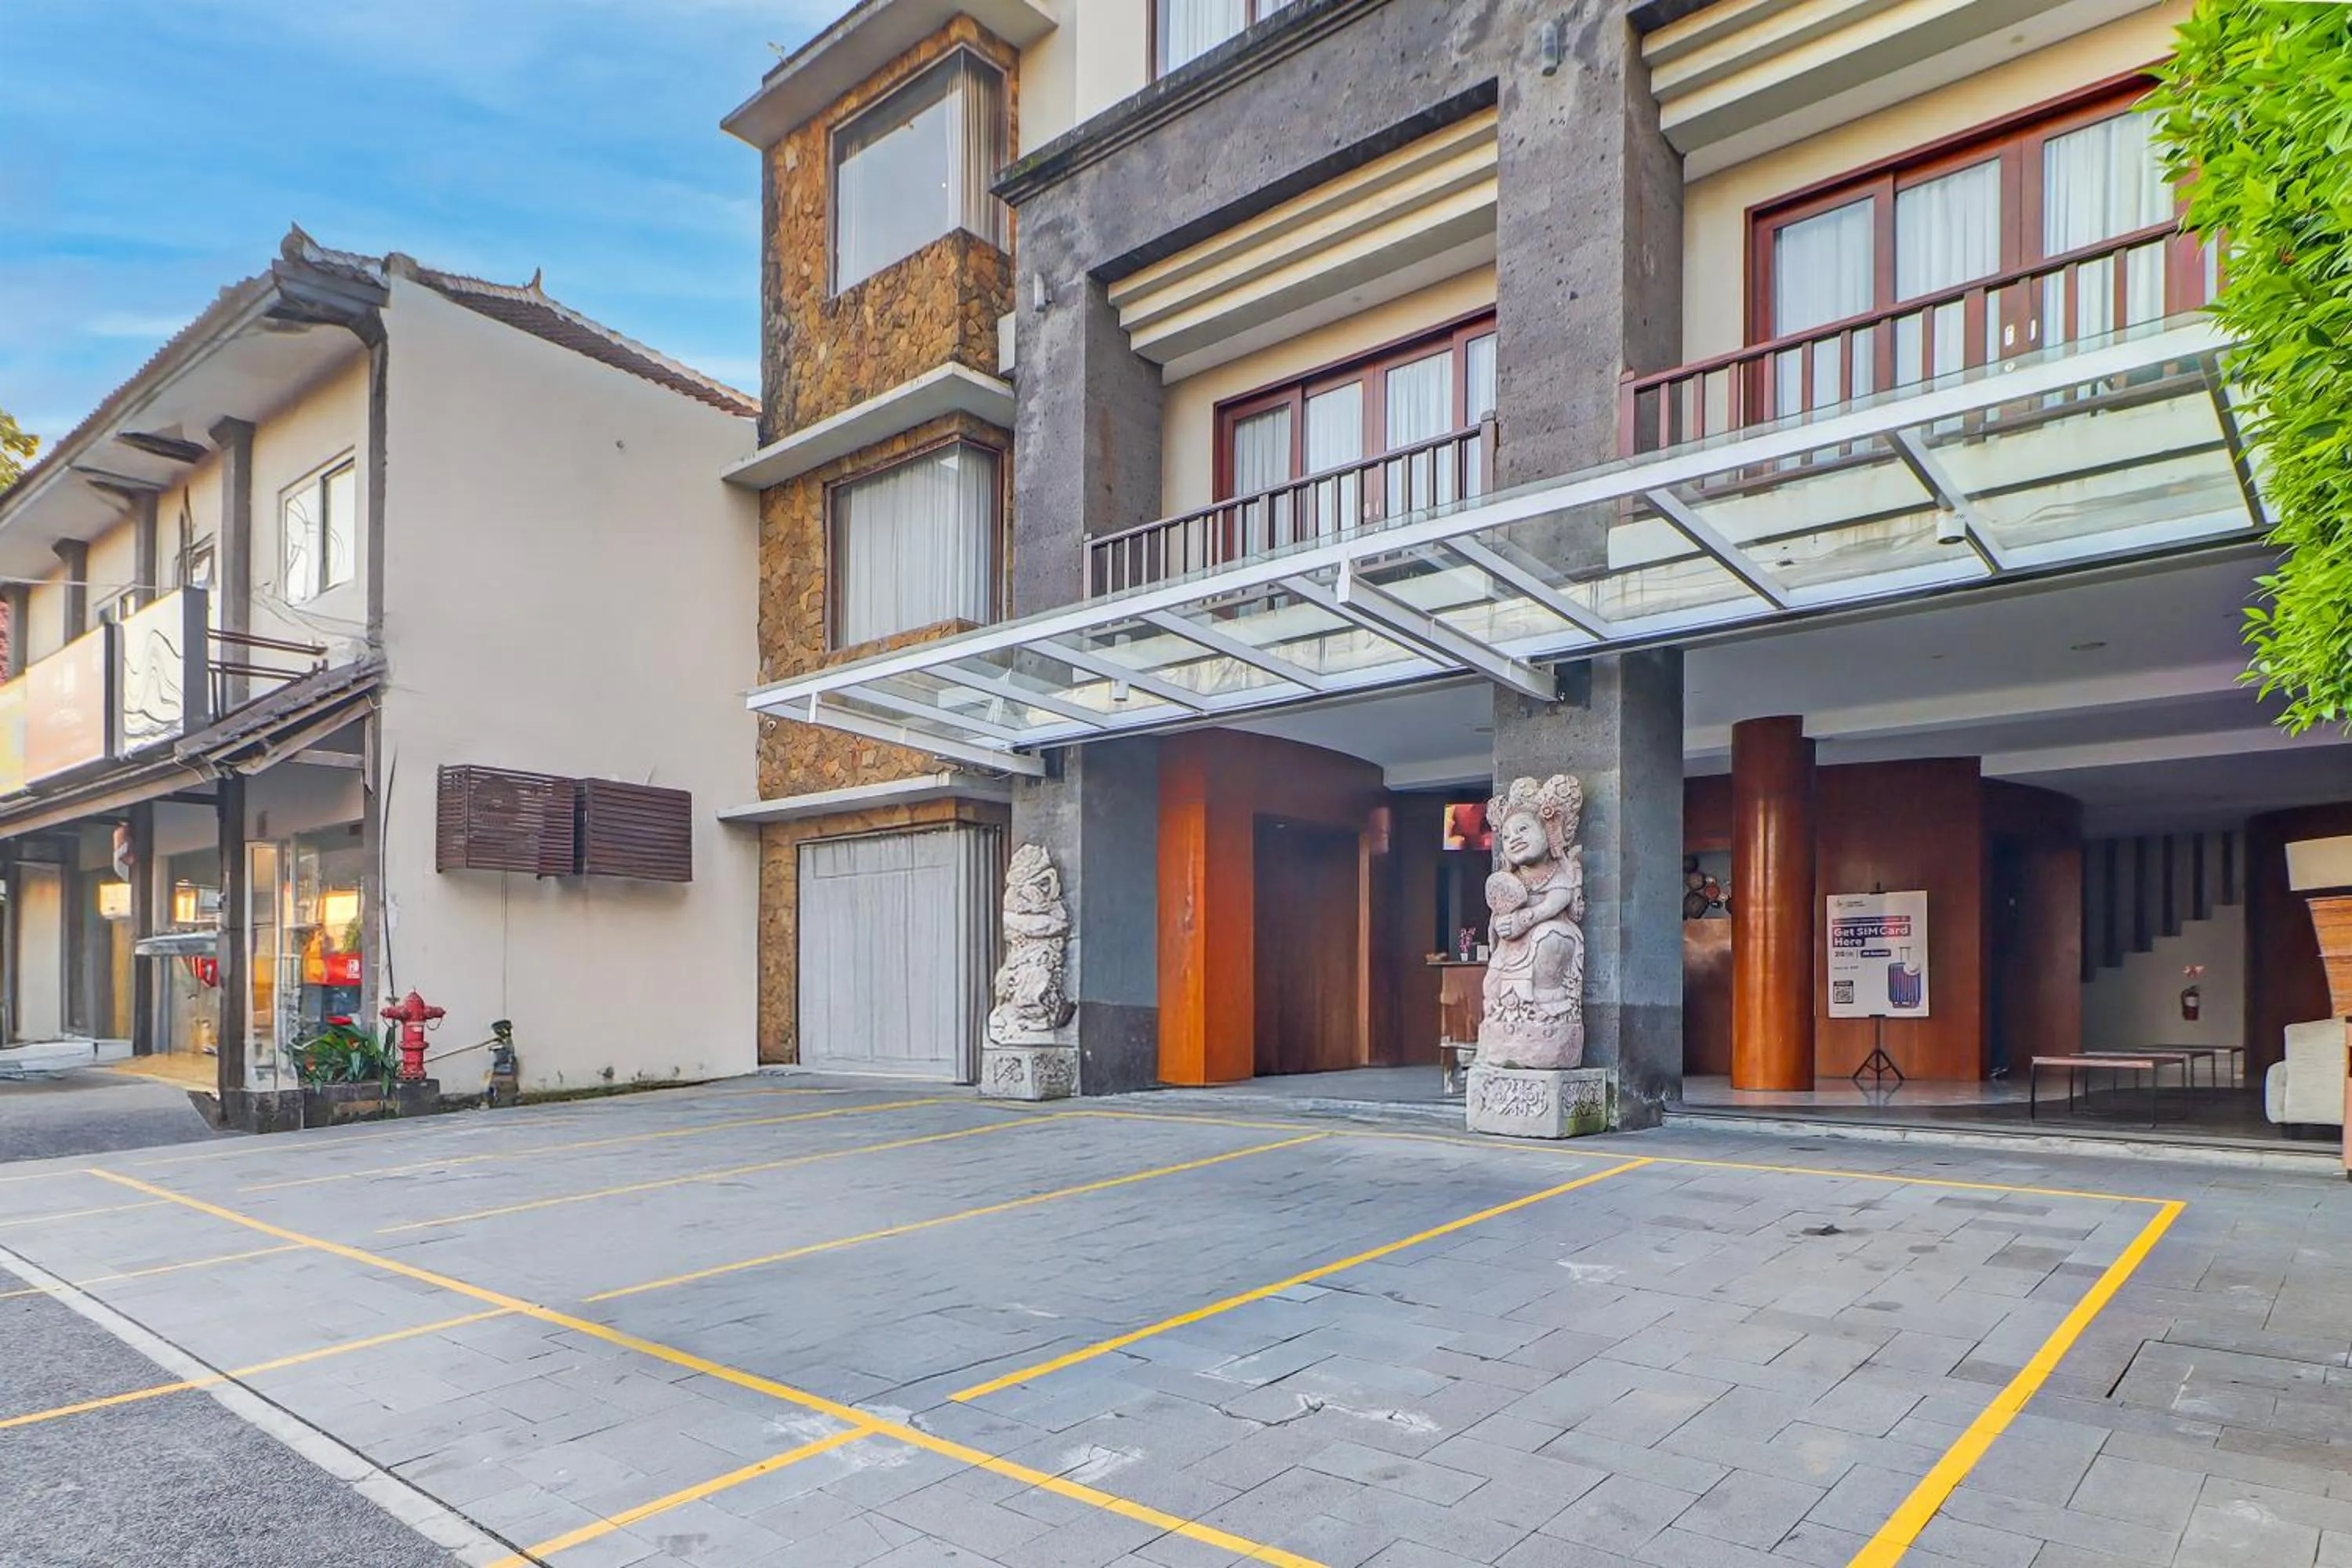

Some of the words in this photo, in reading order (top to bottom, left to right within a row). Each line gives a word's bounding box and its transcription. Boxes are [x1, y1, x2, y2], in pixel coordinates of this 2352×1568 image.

[1834, 927, 1854, 937] Get
[1857, 927, 1878, 936] SIM
[1879, 926, 1908, 935] Card
[1834, 937, 1863, 946] Here
